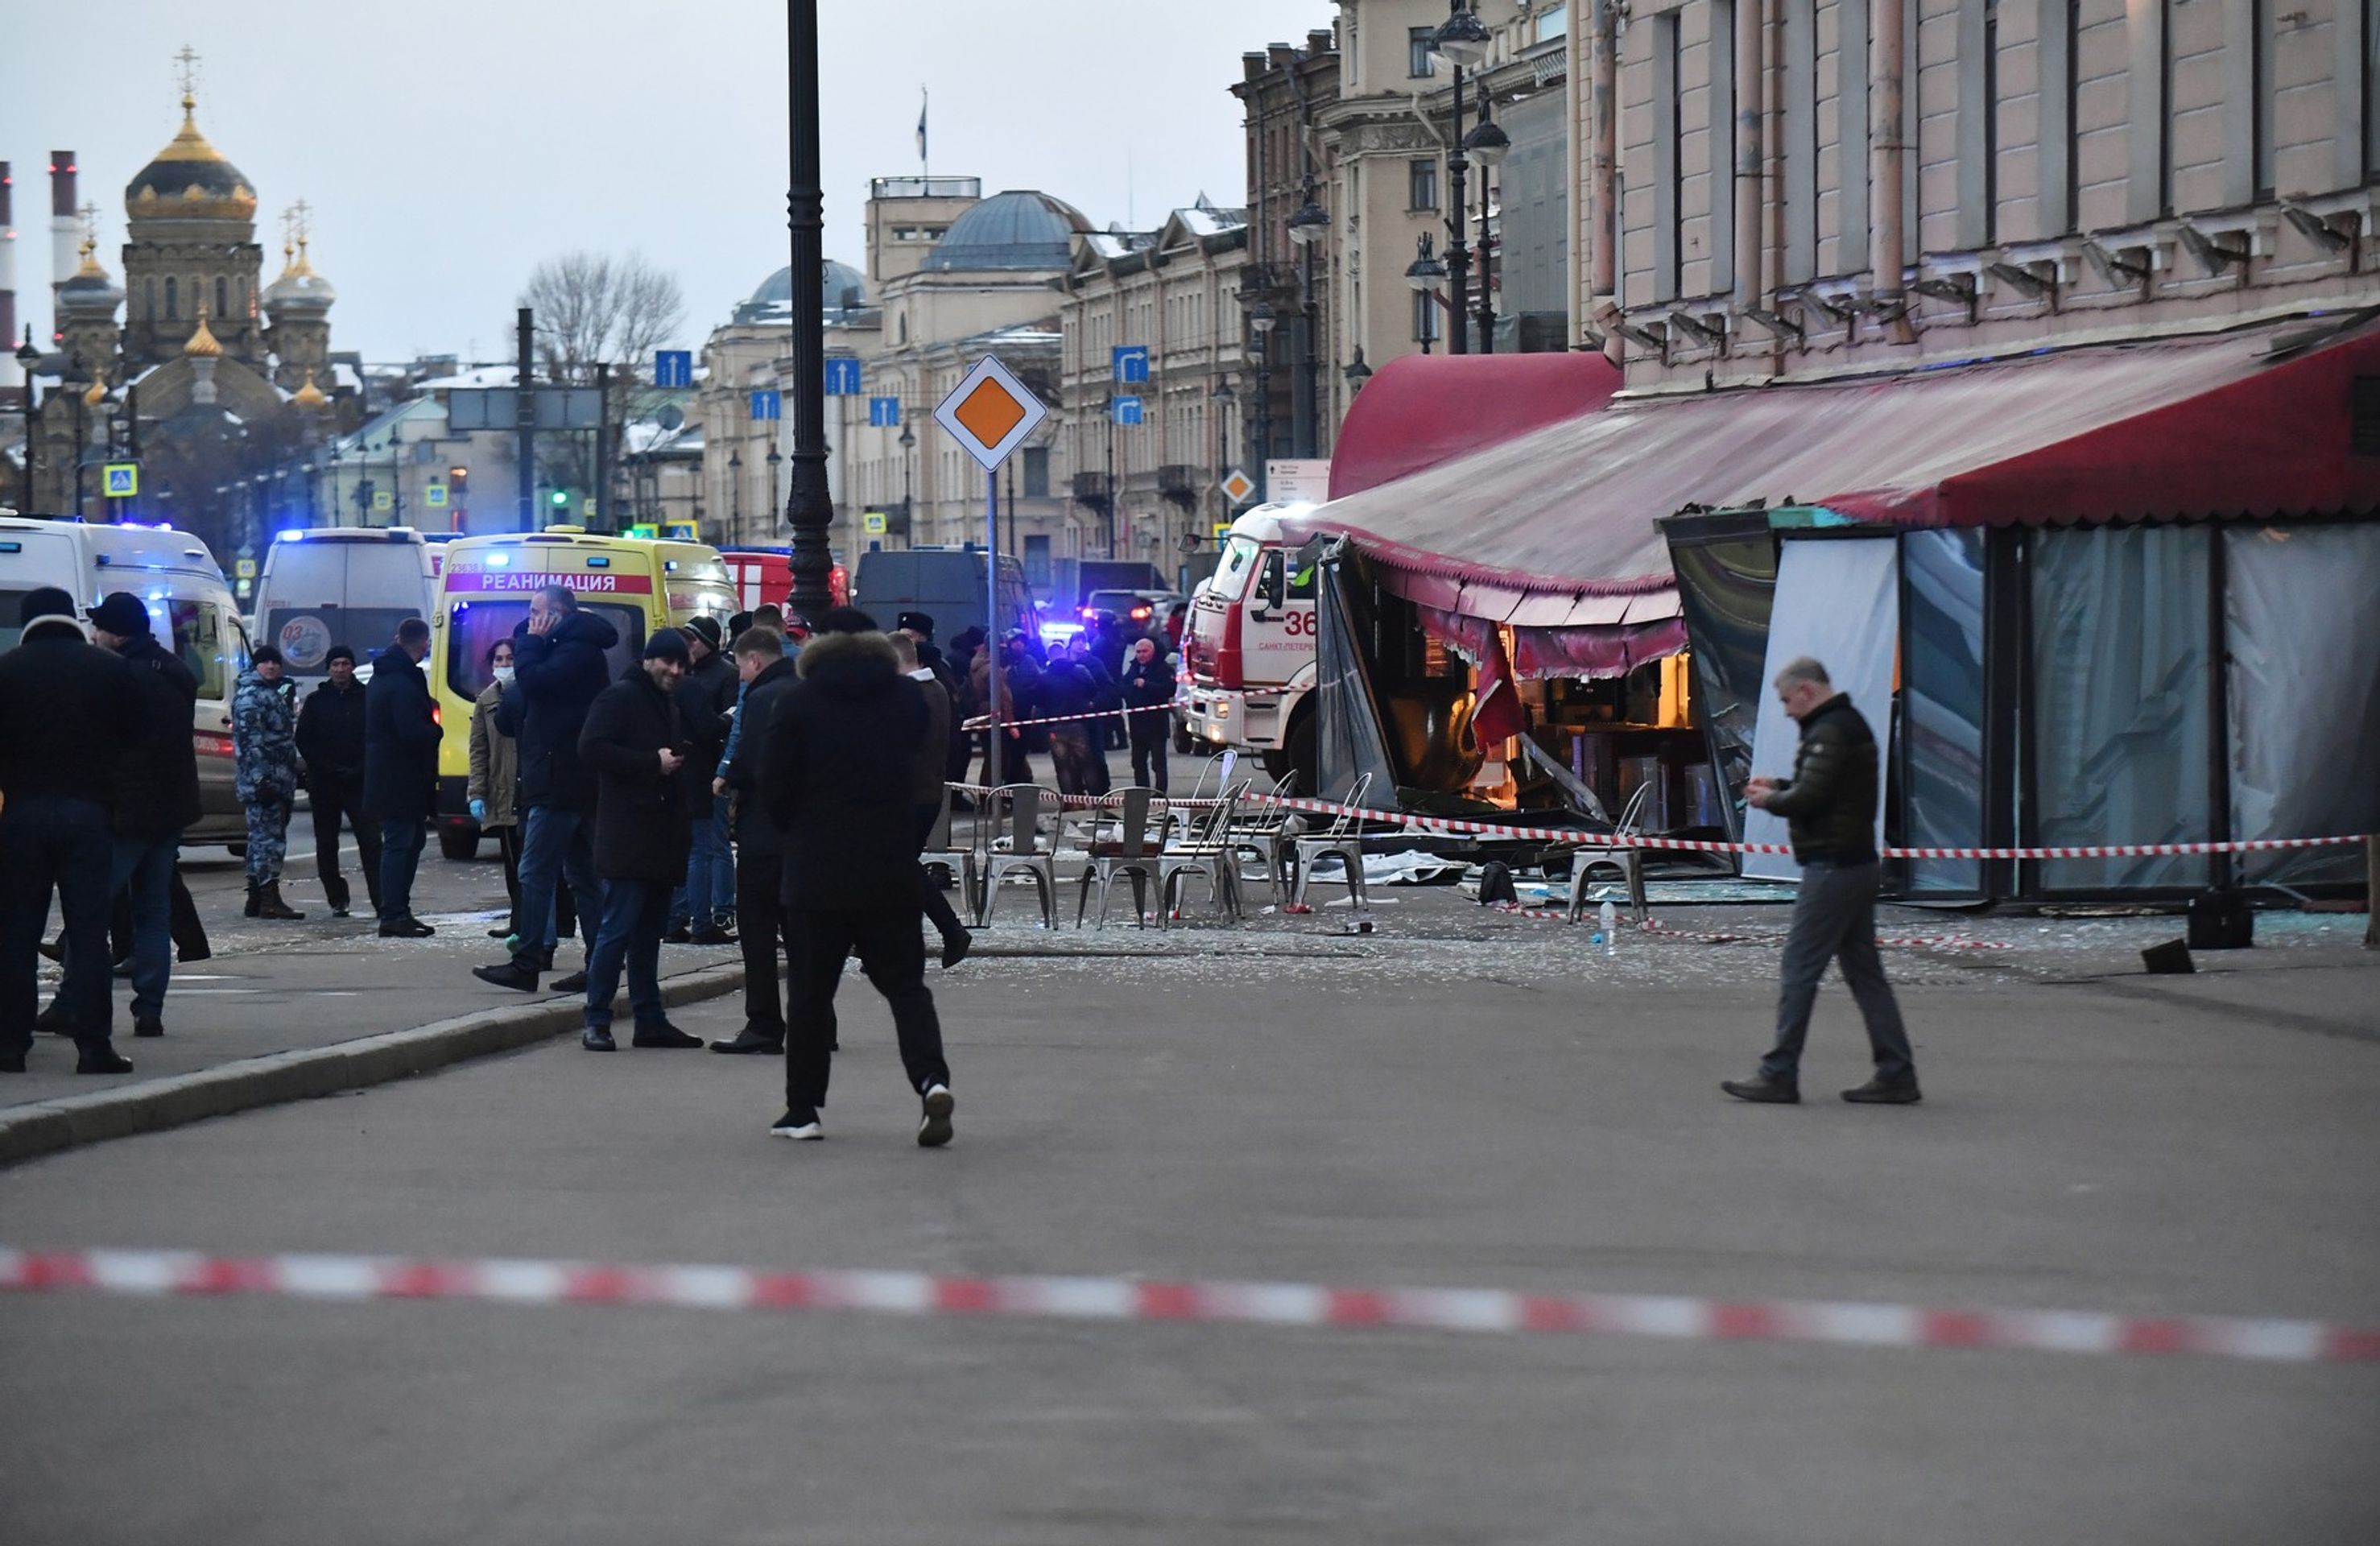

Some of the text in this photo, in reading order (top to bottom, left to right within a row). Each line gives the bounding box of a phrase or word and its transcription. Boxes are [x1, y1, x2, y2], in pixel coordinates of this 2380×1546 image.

[482, 574, 616, 593] РЕАНИМАЦИЯ
[1285, 610, 1316, 636] 36
[283, 624, 303, 641] 03
[1258, 643, 1315, 651] САНКТ-ПЕТЕРБ
